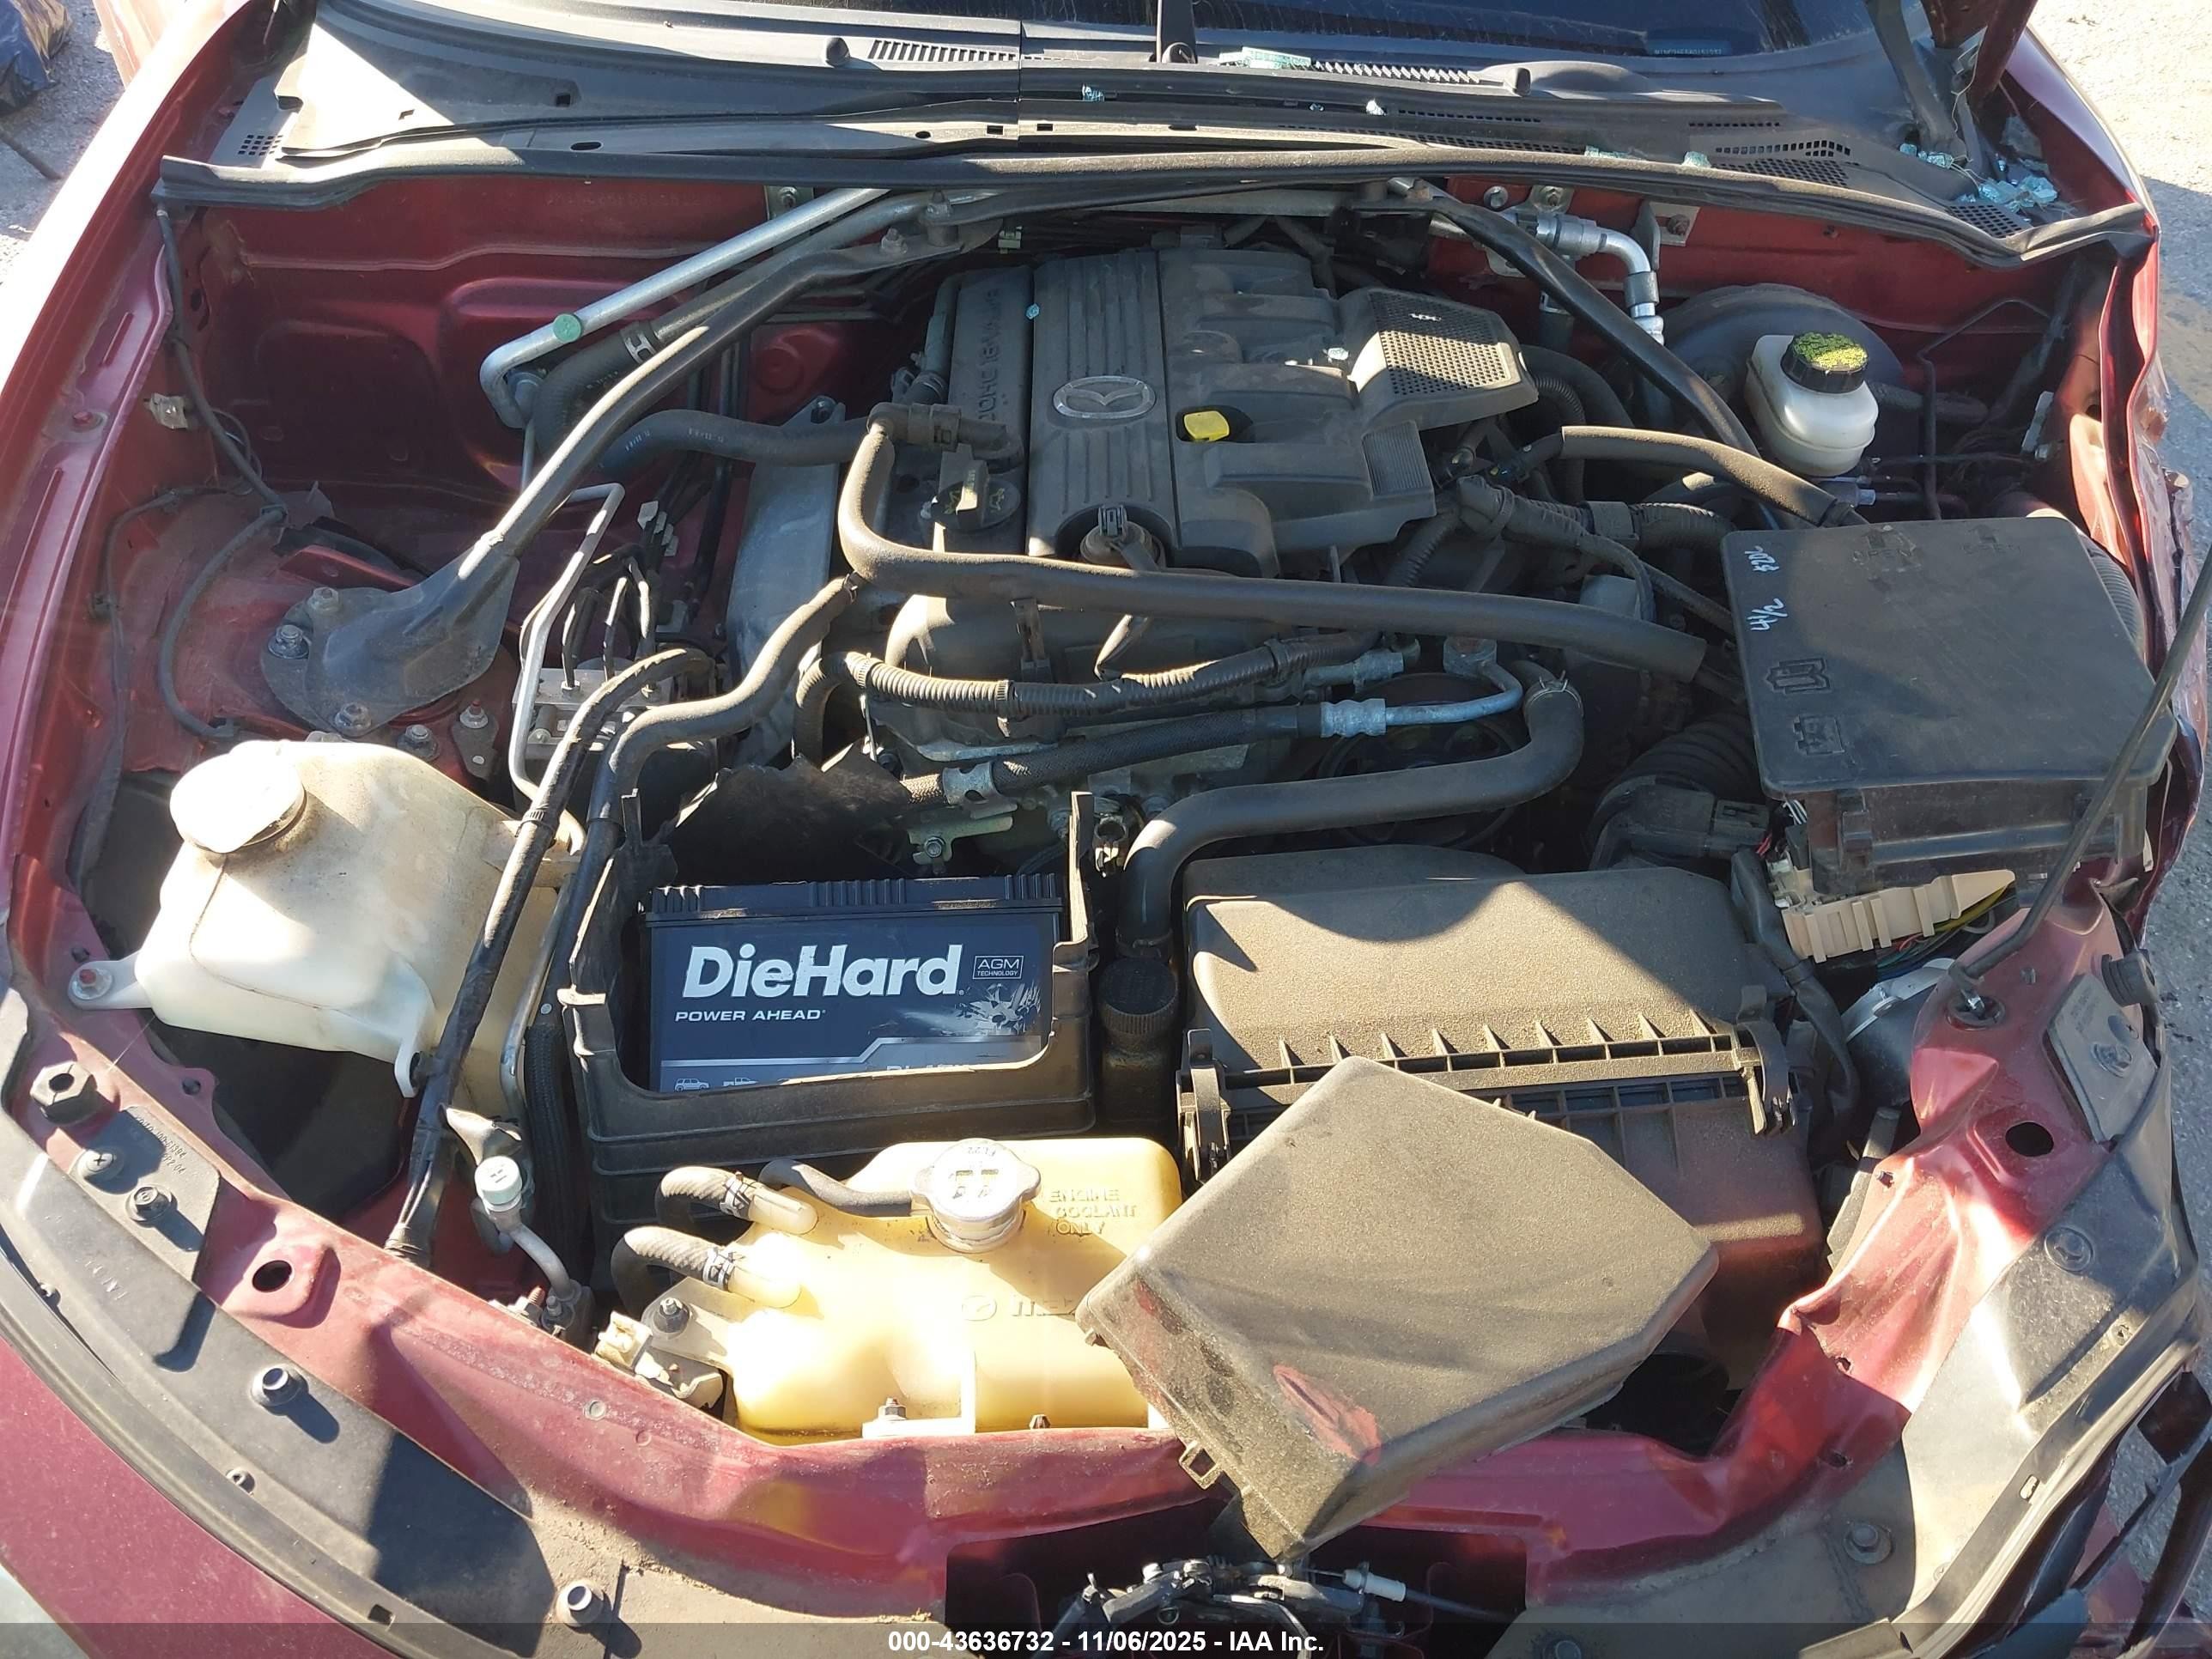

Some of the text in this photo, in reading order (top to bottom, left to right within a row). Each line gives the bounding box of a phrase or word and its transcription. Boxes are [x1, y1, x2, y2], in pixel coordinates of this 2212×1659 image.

[683, 943, 963, 998] DieHard
[977, 958, 1020, 969] AGM
[674, 1009, 822, 1022] POWER AHEAD
[1049, 1188, 1120, 1202] ENGINE
[1055, 1204, 1138, 1218] COOLANT
[1056, 1219, 1106, 1235] ONLY
